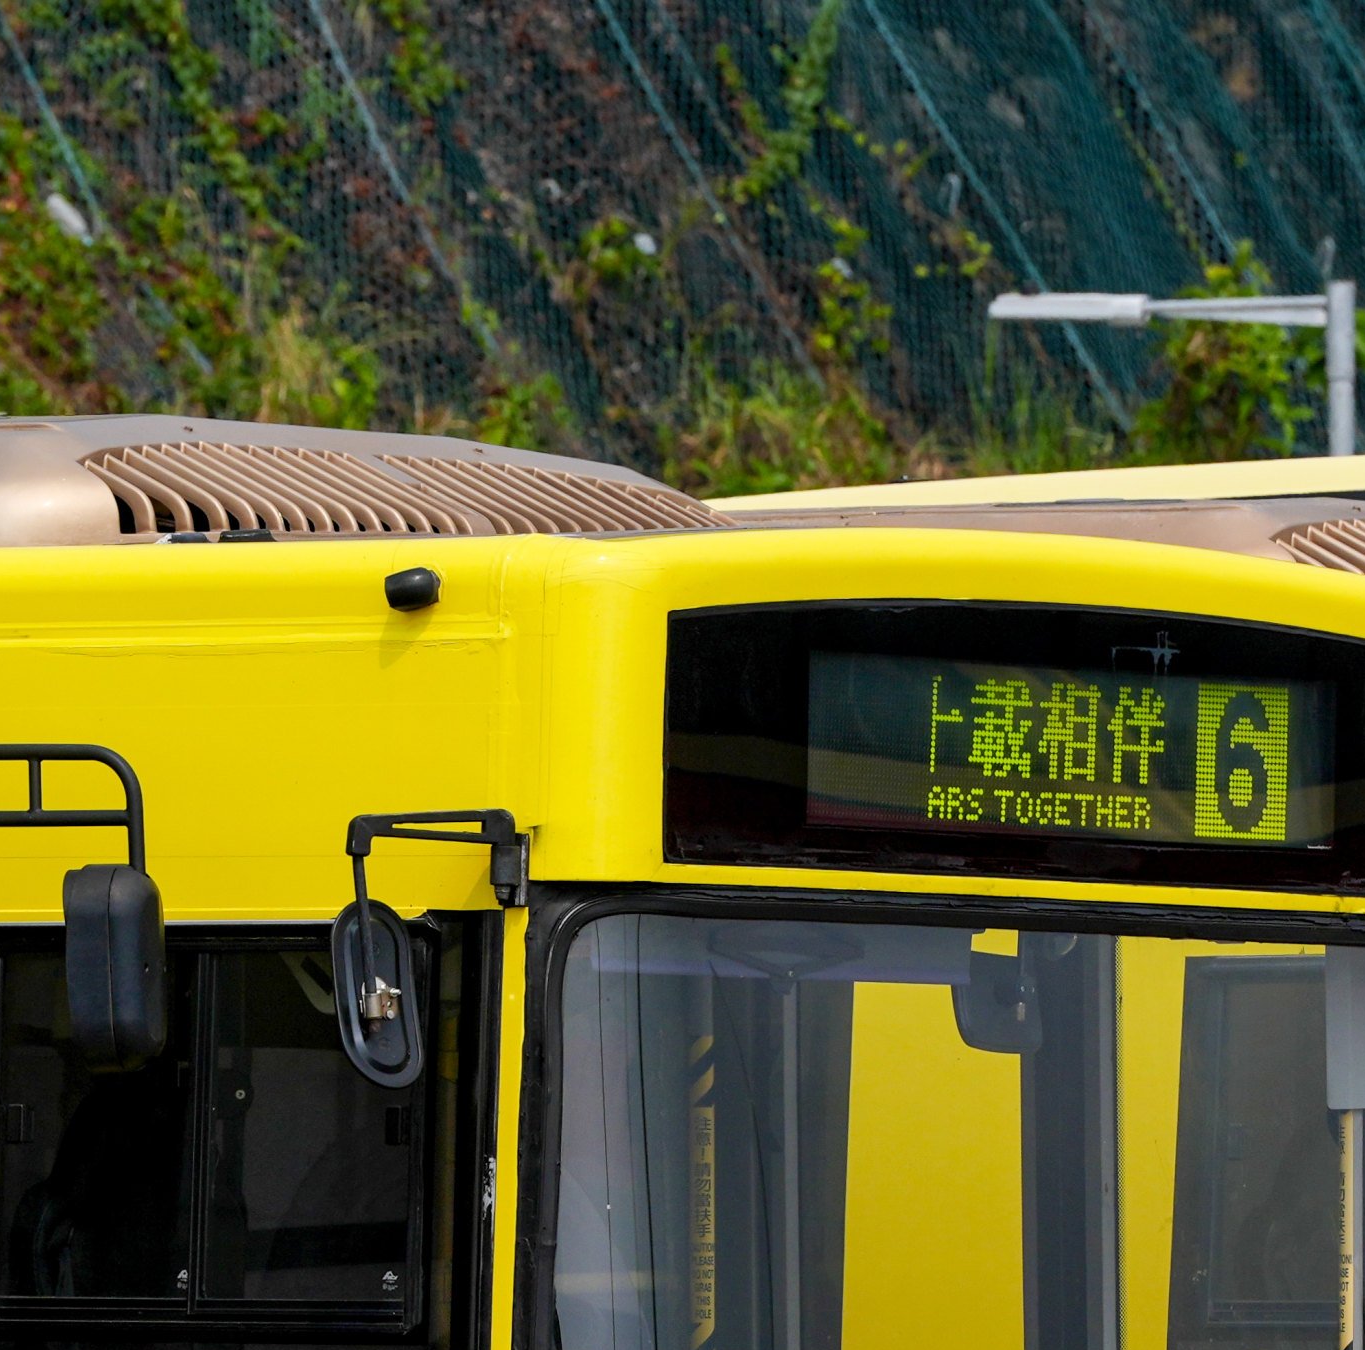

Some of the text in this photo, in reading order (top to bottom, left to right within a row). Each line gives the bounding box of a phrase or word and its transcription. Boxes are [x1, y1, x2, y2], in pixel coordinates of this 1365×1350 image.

[927, 785, 1151, 831] ARS TOGETHER
[1209, 687, 1276, 837] 6
